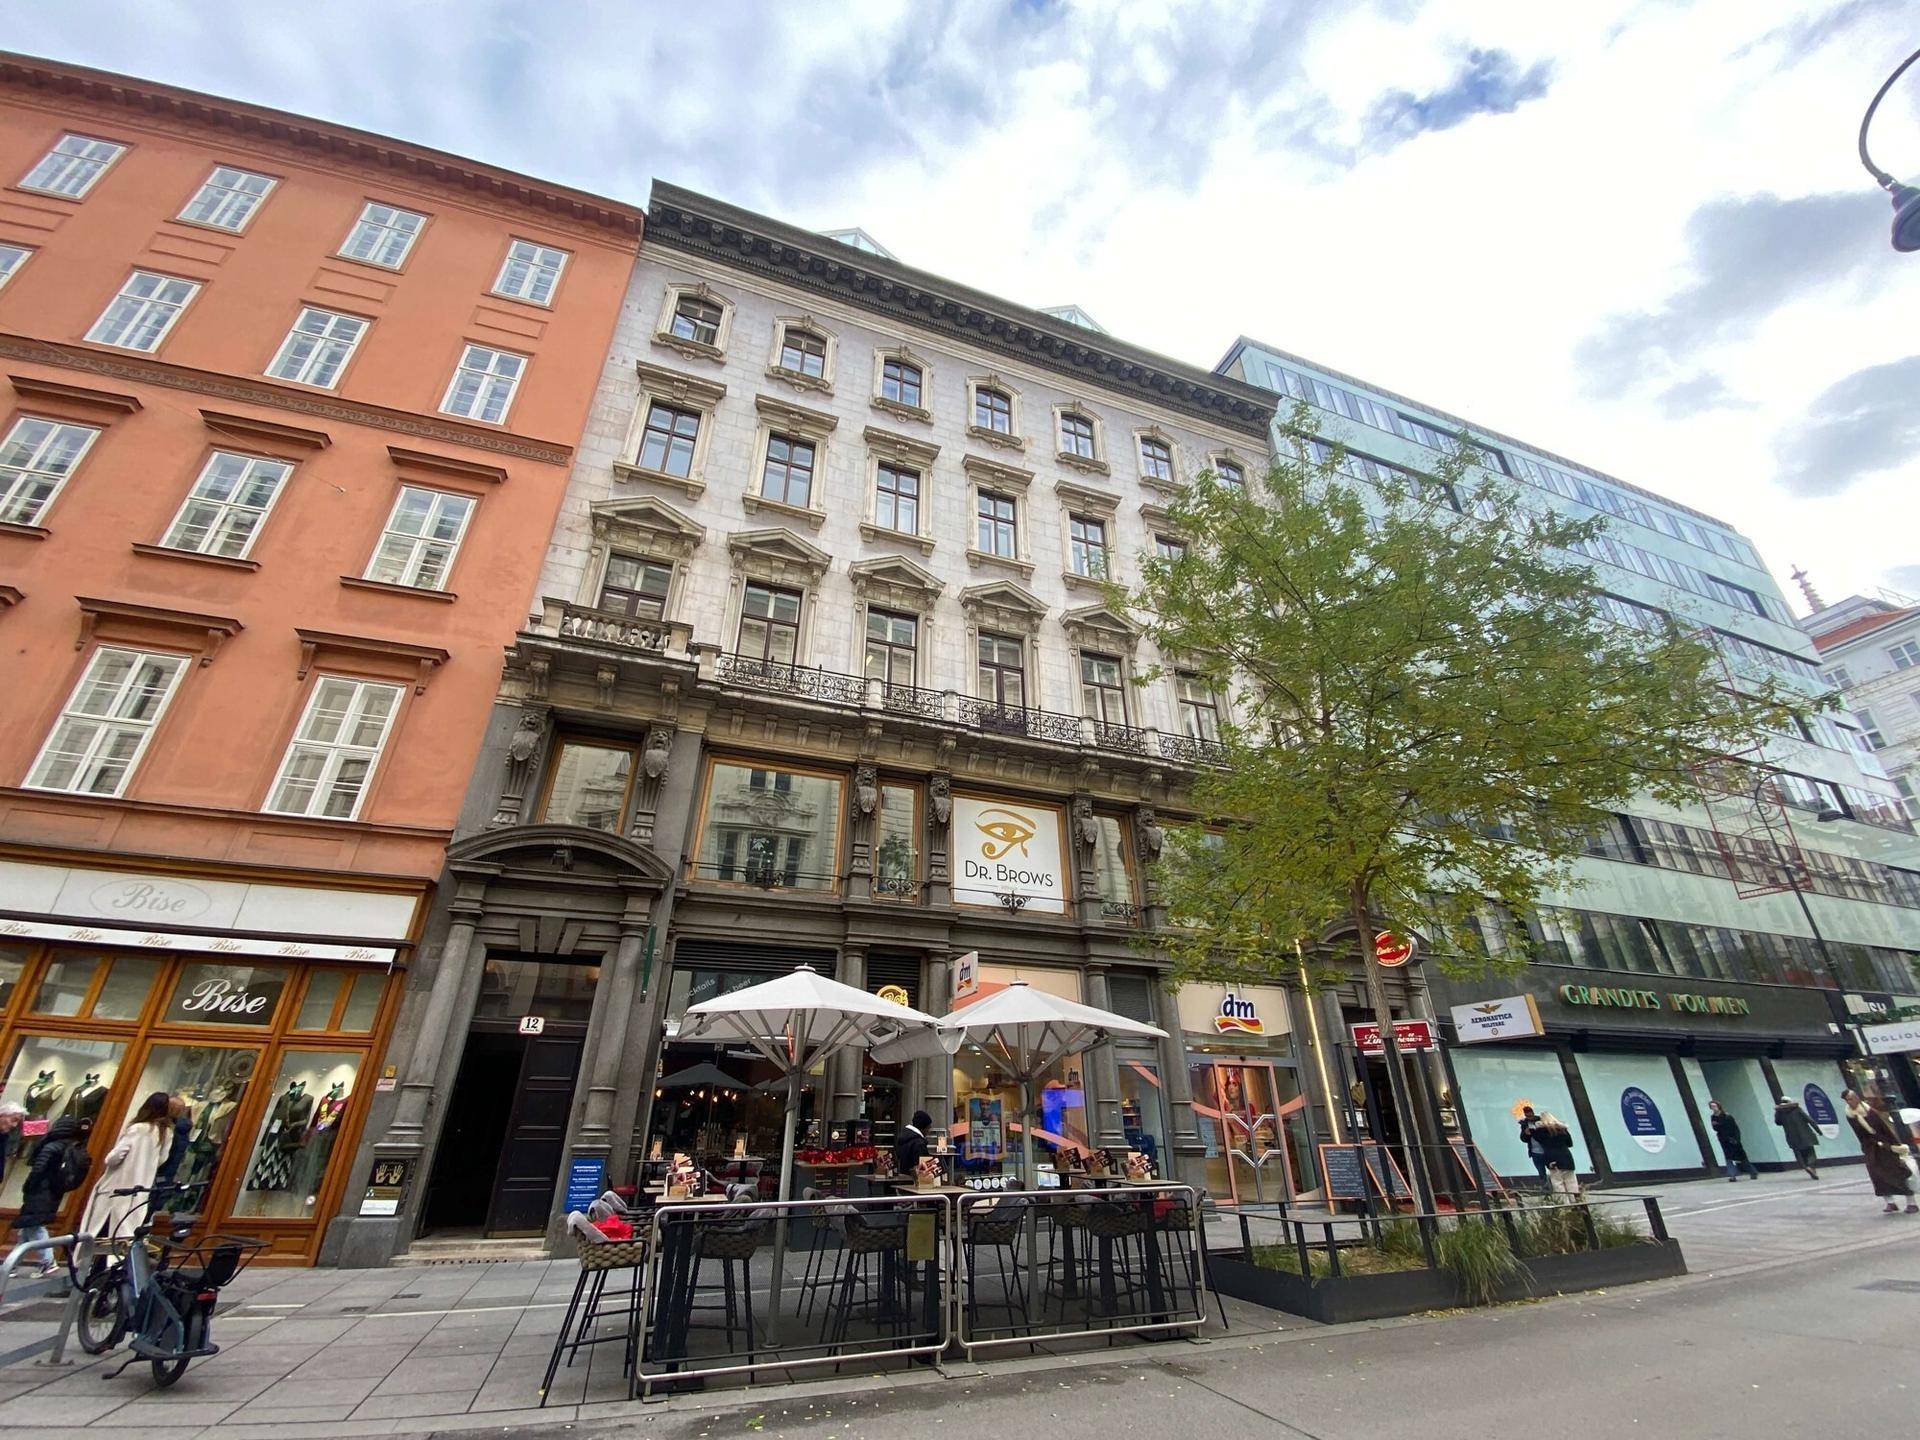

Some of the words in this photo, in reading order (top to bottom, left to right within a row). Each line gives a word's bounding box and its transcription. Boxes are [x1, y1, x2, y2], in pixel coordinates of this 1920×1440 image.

[996, 863, 1054, 888] BROWS
[112, 882, 188, 913] Bise
[68, 928, 103, 942] Bise
[138, 934, 173, 948] Bise
[208, 938, 243, 953] Bise
[277, 943, 311, 957] Bise
[344, 947, 378, 961] Bise
[959, 962, 971, 981] dm
[182, 978, 267, 1014] Bise
[1561, 984, 1661, 1010] GRANDITS
[1669, 993, 1711, 1012] FOR
[1708, 996, 1751, 1015] MEN
[1222, 993, 1255, 1018] dm
[525, 1017, 539, 1029] 12
[1471, 1013, 1513, 1024] AERONAUTICA
